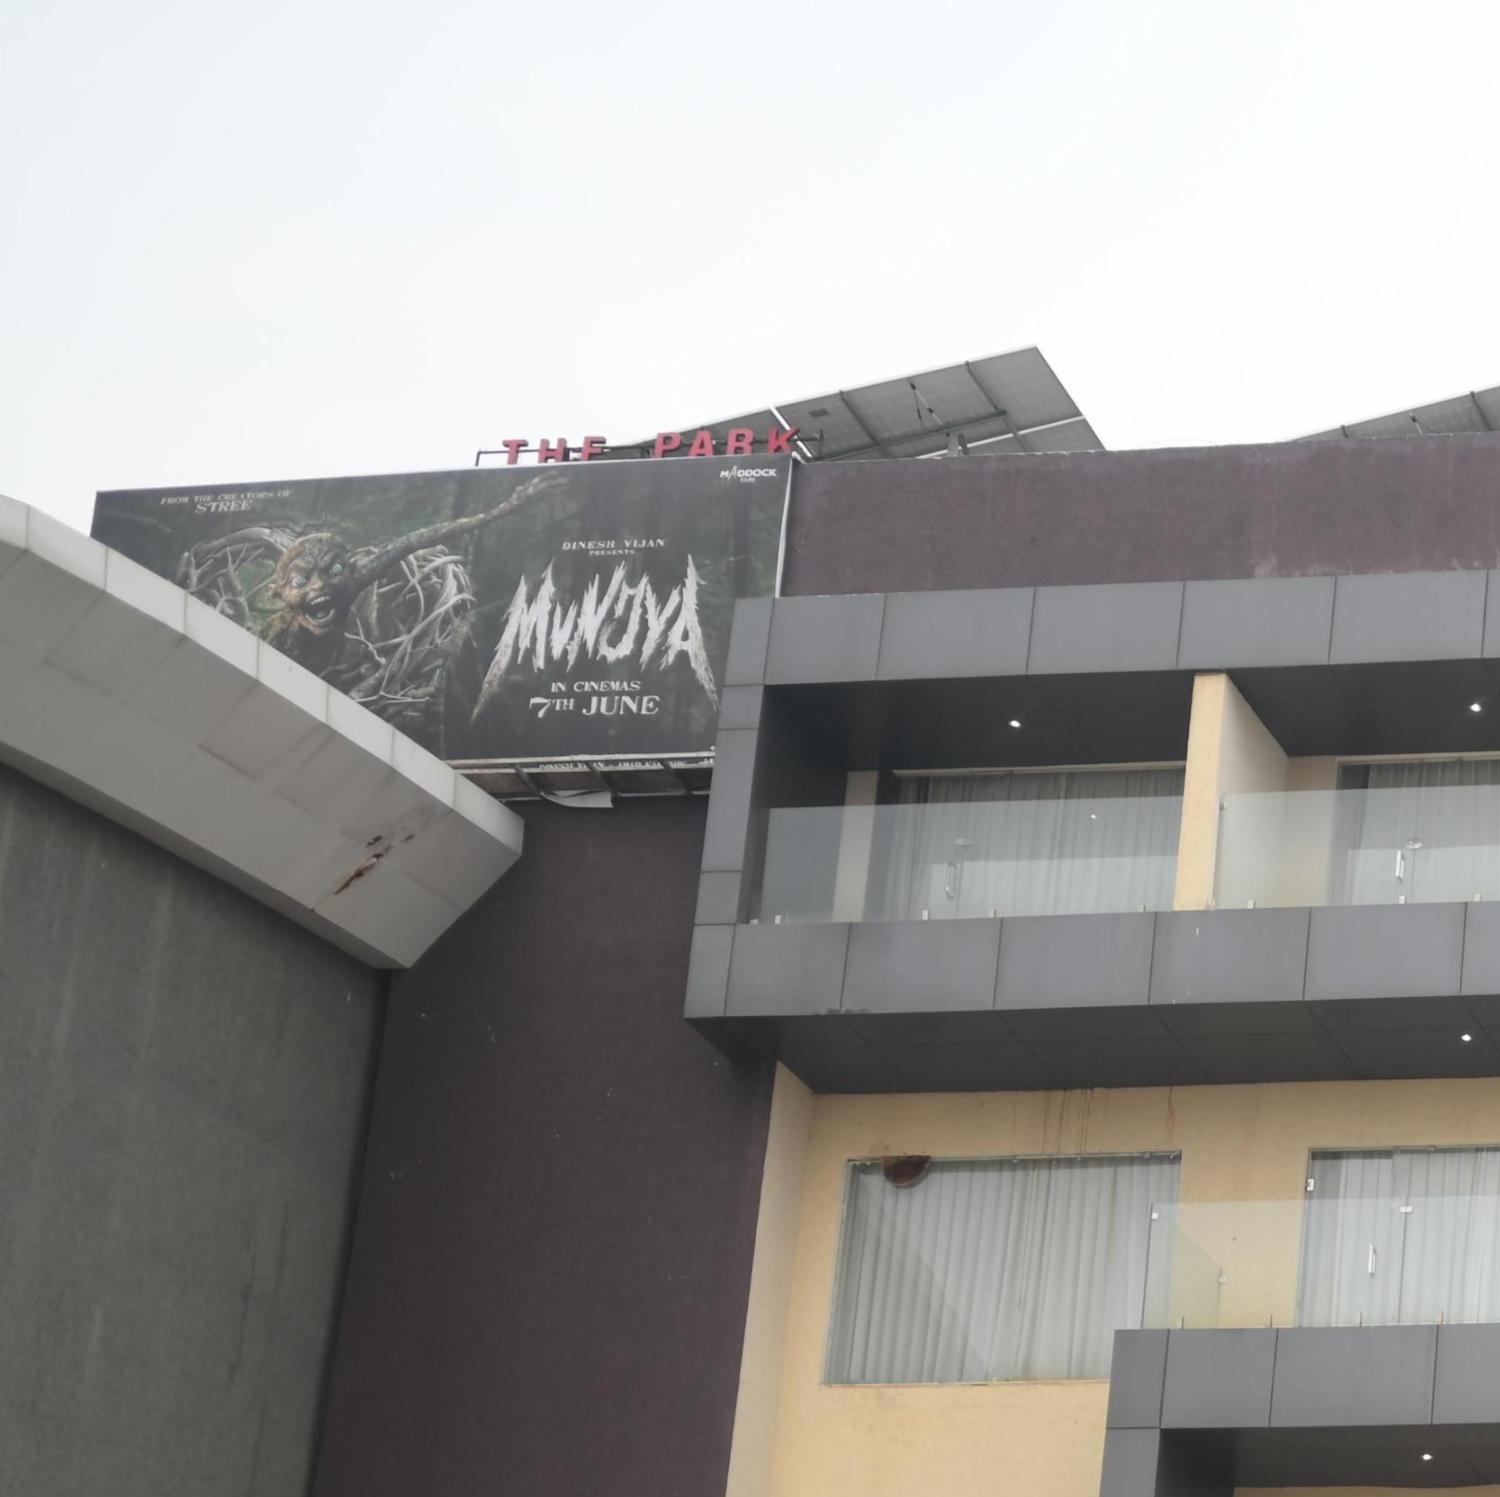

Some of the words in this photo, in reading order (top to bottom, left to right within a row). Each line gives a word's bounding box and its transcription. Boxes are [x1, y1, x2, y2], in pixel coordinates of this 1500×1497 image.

[653, 426, 800, 458] PARK
[720, 465, 776, 480] MADDOCK
[194, 495, 214, 503] THE
[216, 491, 274, 501] CREATORS
[194, 500, 253, 514] STREE
[562, 540, 615, 551] DINESH
[624, 538, 665, 548] VIJAN
[589, 548, 635, 556] PRESENTS
[551, 681, 566, 693] IN
[573, 680, 642, 692] CINEMAS
[582, 695, 661, 716] JUNE
